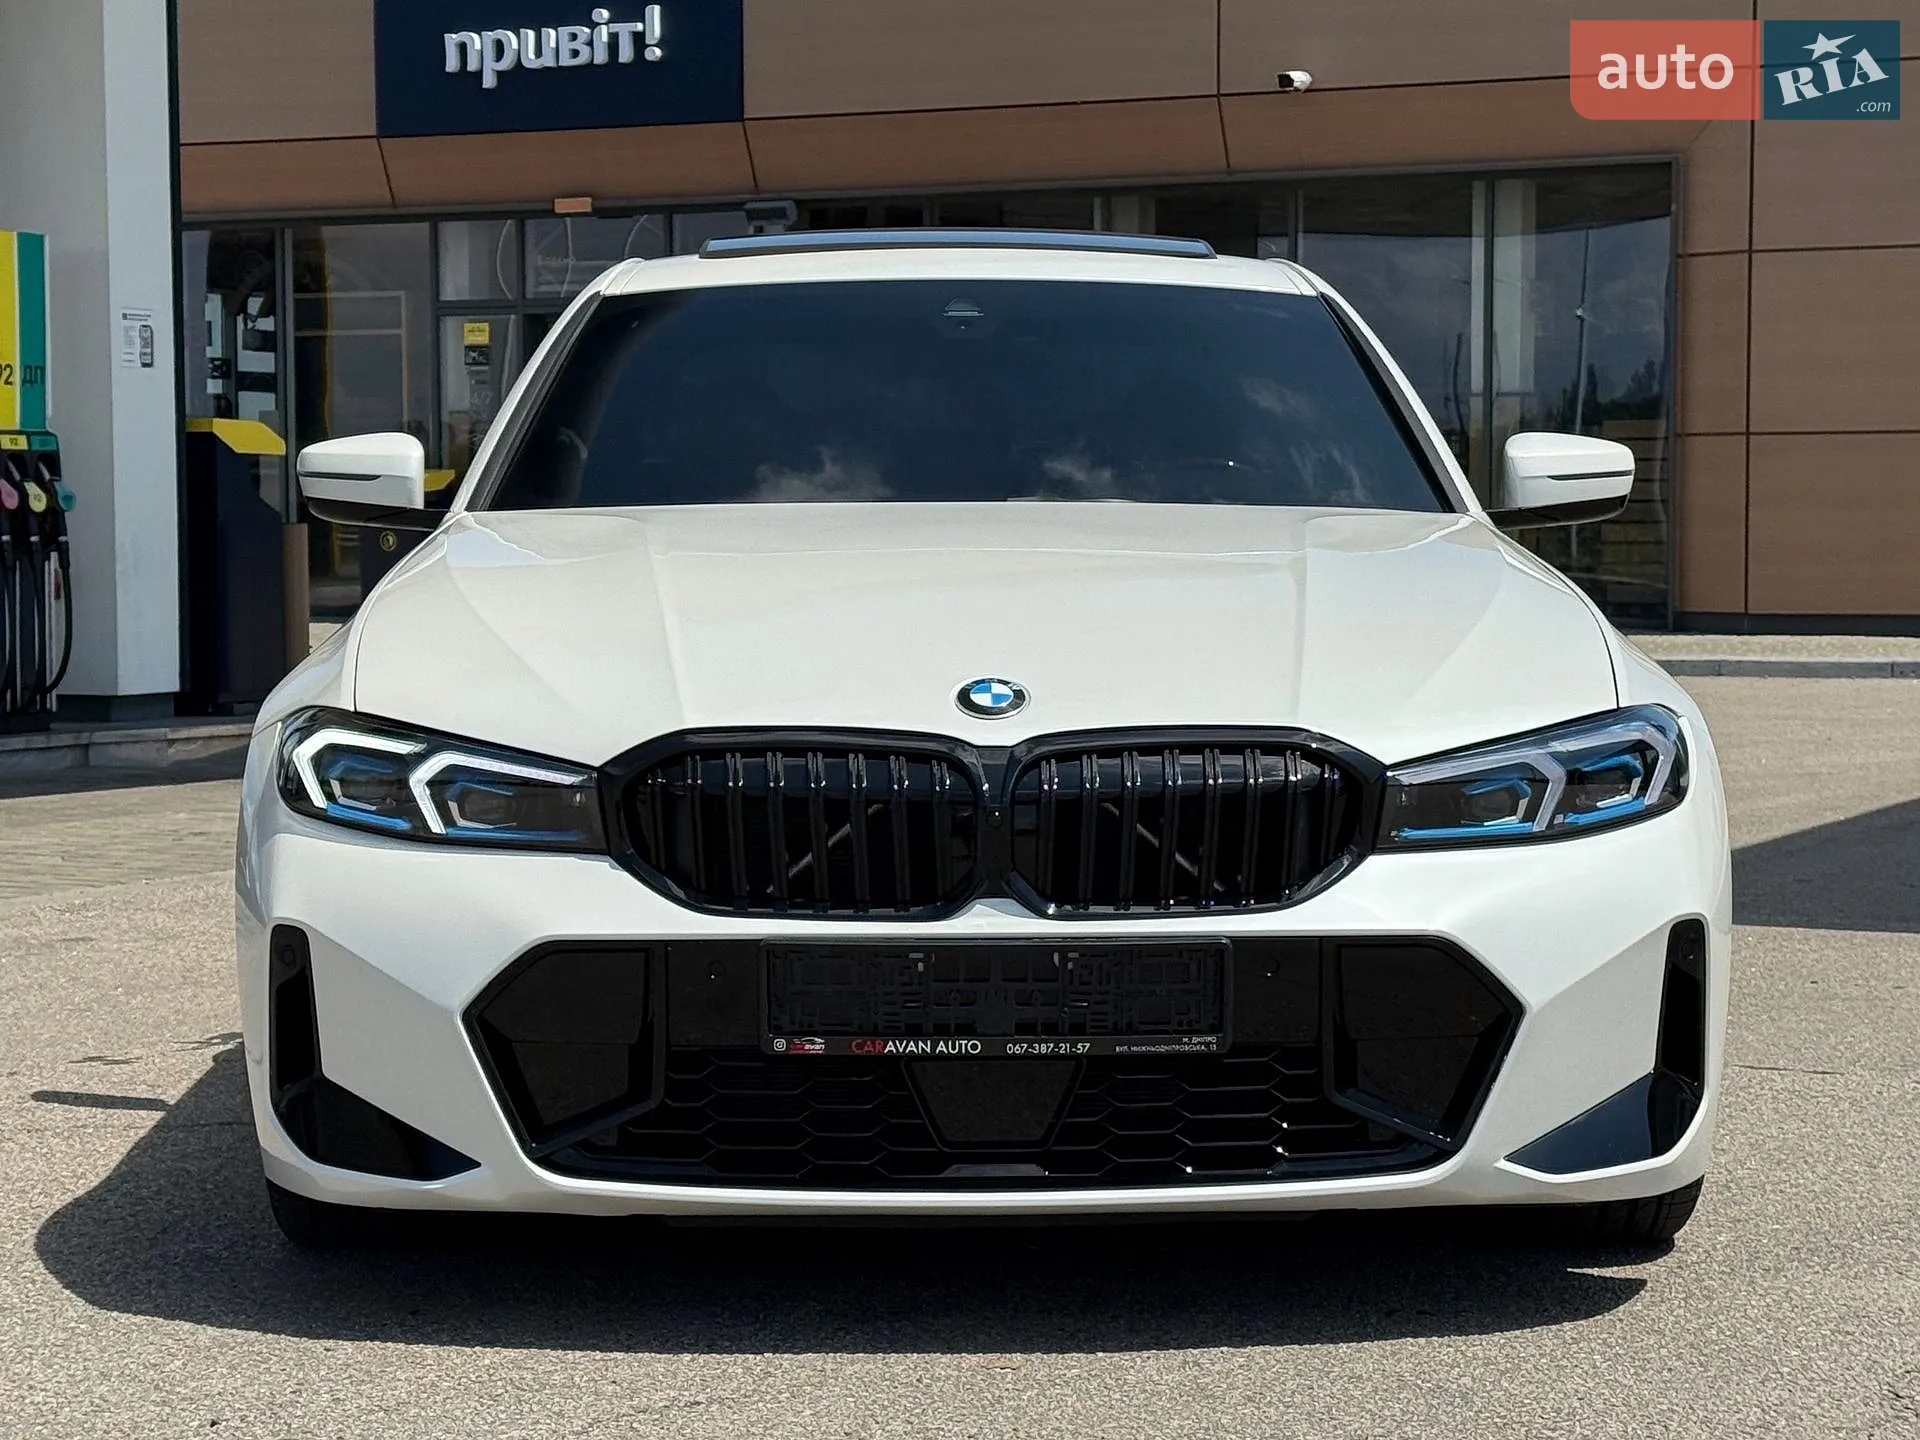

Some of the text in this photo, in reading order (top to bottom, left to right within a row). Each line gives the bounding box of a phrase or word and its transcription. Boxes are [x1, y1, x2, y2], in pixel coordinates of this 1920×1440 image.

[443, 4, 663, 89] привіт!
[851, 1039, 981, 1054] CARAVAN AUTO
[1006, 1042, 1091, 1055] 067-387-21-57
